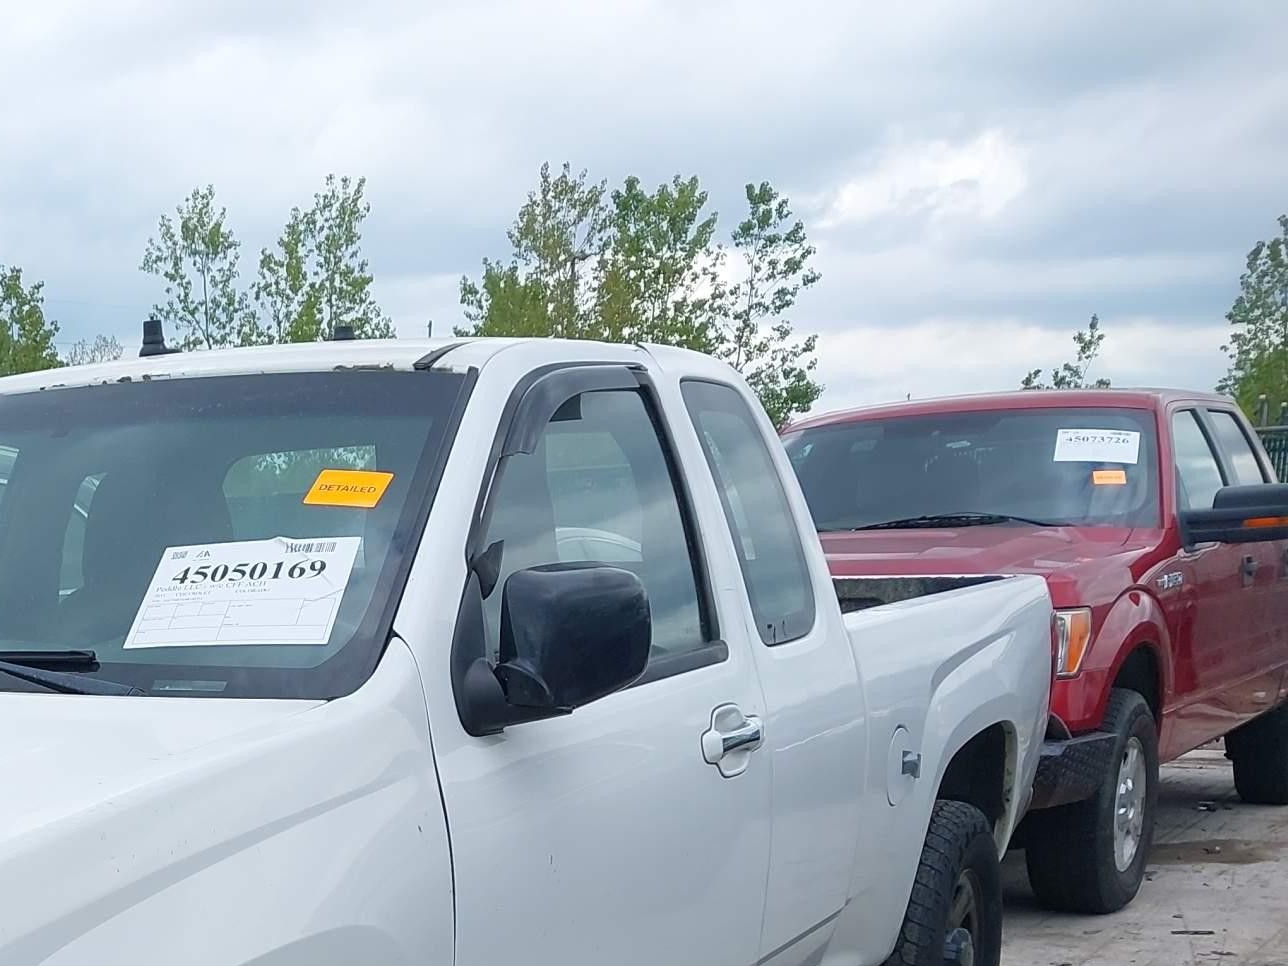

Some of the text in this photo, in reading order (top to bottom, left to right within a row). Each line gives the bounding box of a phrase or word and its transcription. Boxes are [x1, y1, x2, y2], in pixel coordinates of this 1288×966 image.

[1065, 435, 1130, 444] 45073726
[319, 484, 377, 494] DETAILED
[172, 560, 327, 584] 45050169
